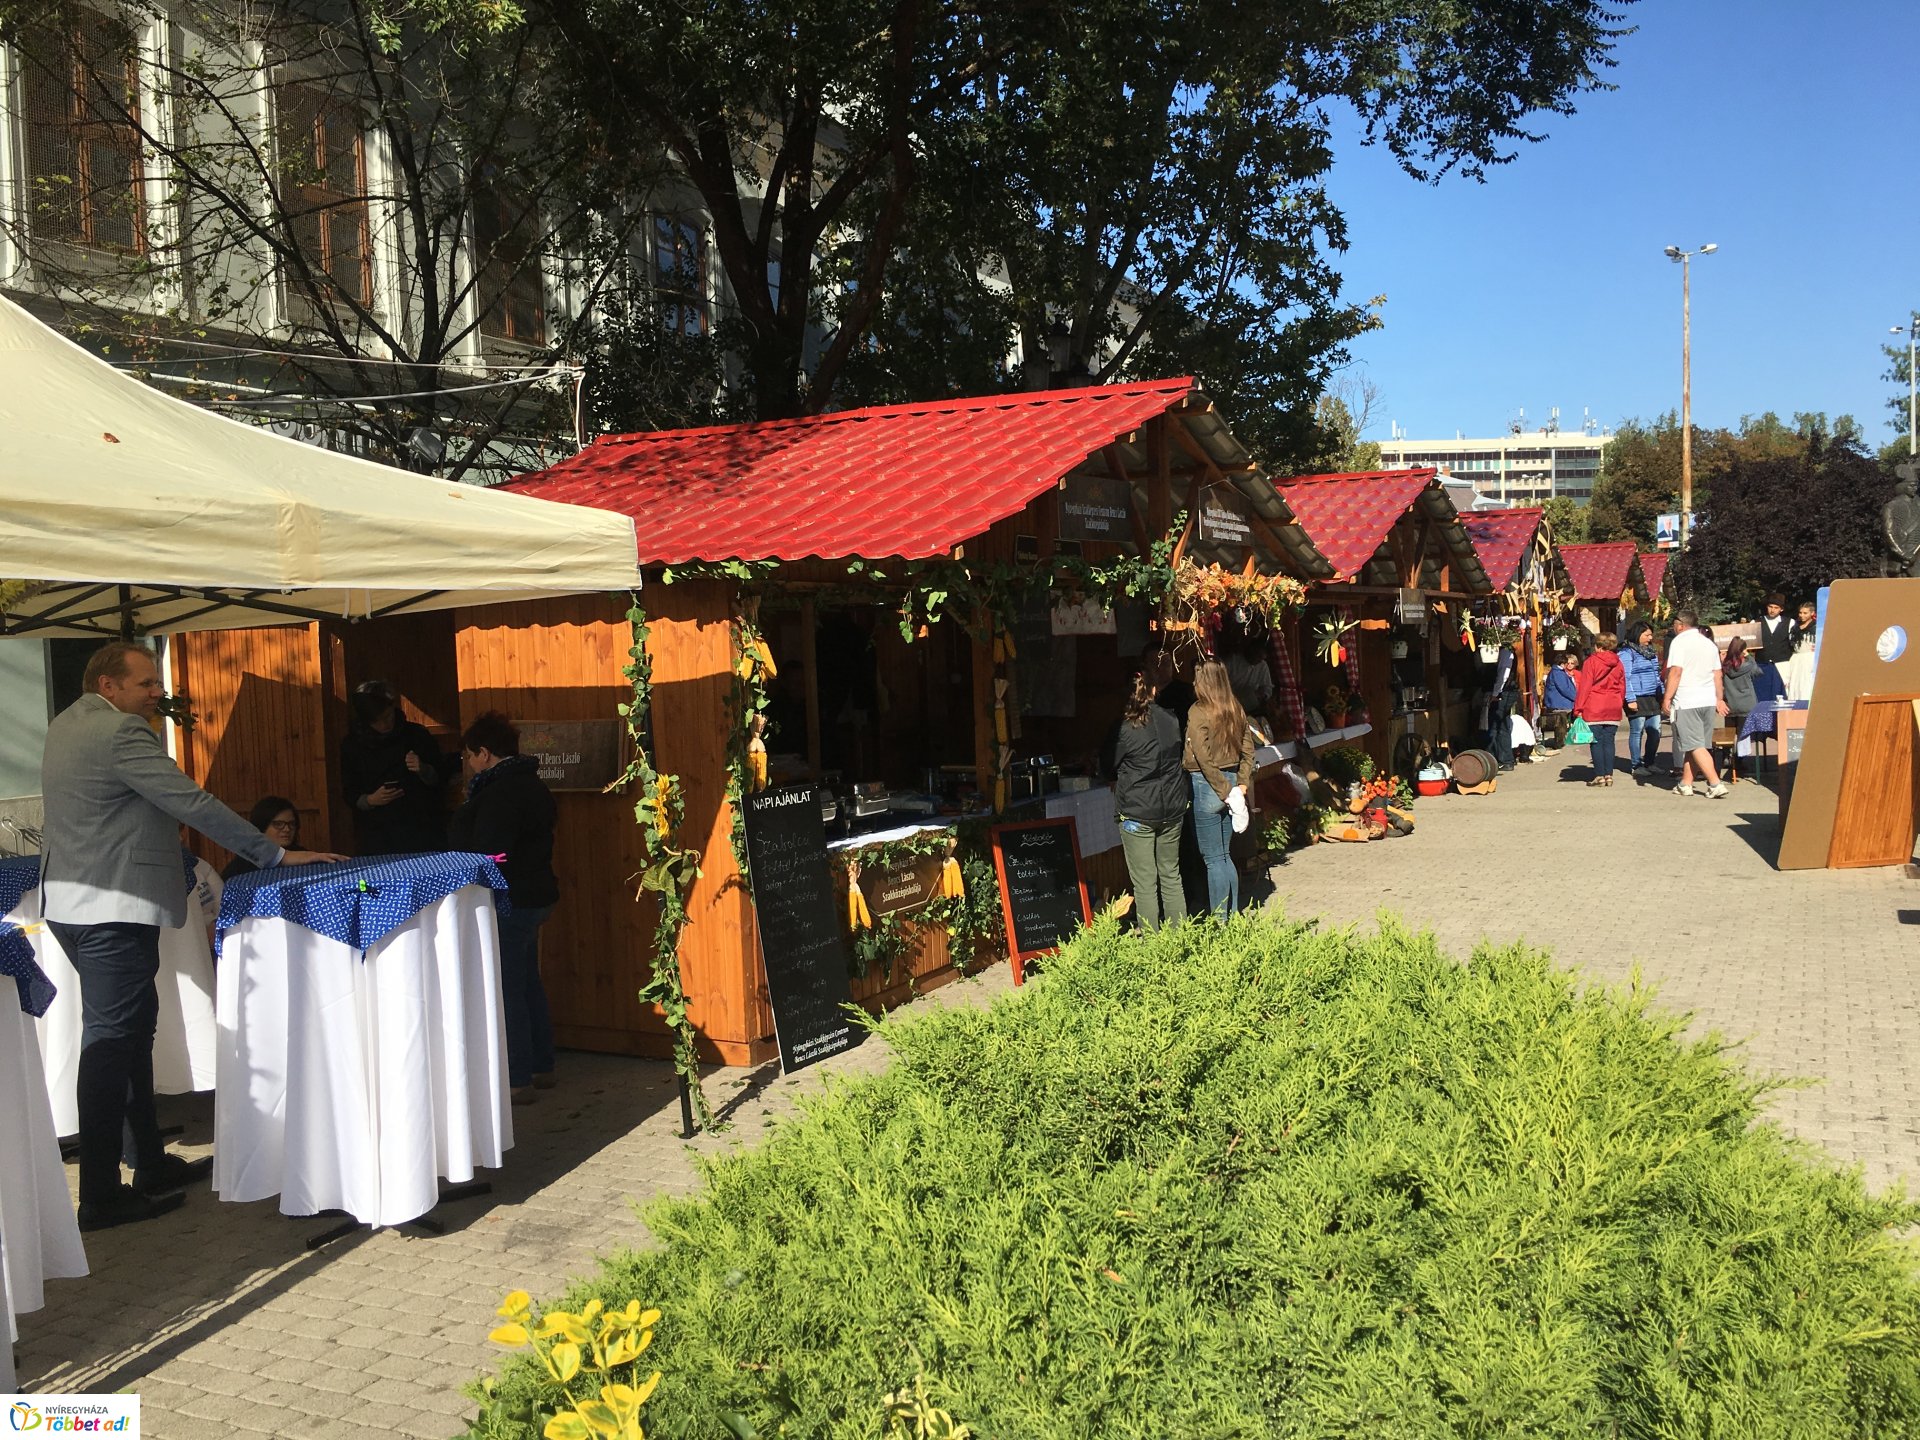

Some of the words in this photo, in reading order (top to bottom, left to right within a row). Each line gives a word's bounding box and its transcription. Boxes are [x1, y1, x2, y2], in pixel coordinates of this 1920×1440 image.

[545, 752, 562, 765] Bencs
[562, 751, 581, 764] László
[752, 796, 774, 811] NAPI
[774, 790, 811, 808] AJÁNLAT
[900, 870, 915, 883] László
